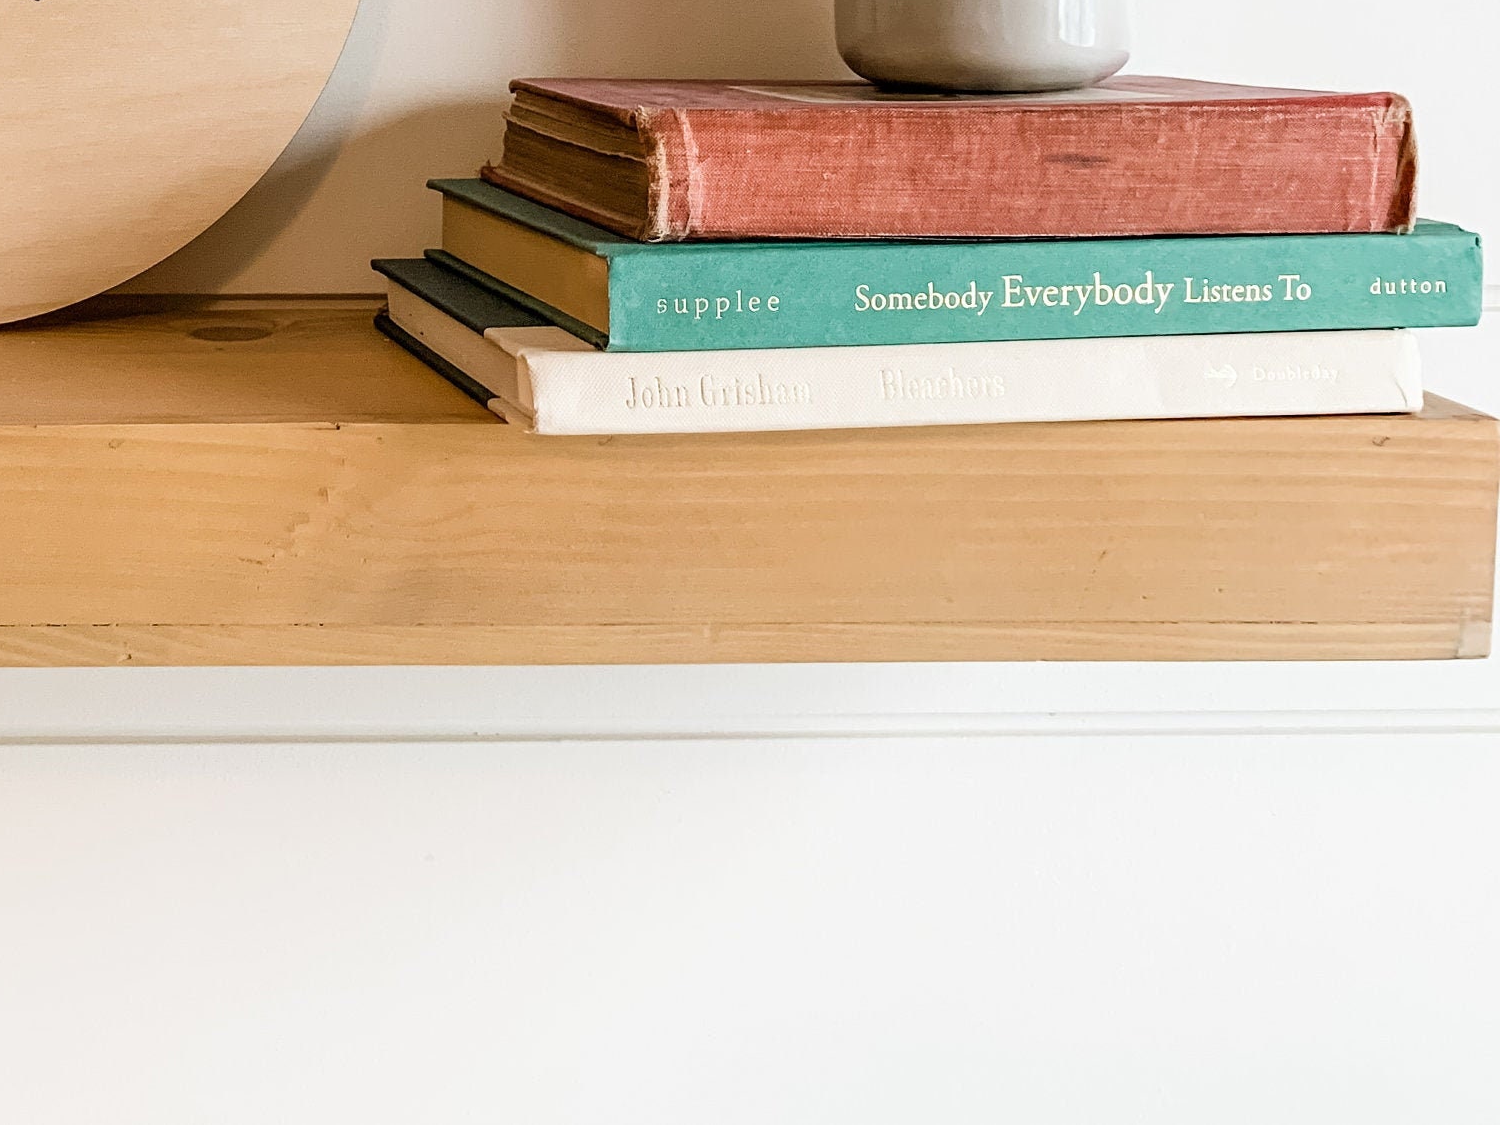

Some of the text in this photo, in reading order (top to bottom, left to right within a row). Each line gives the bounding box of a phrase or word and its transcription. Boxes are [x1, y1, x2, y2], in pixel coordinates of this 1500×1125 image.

[854, 270, 1313, 316] Somebody Everybody Listens To
[1369, 277, 1448, 296] dutton
[656, 290, 781, 320] supplee
[624, 372, 813, 410] John Grisham
[878, 367, 1007, 402] Bleachers
